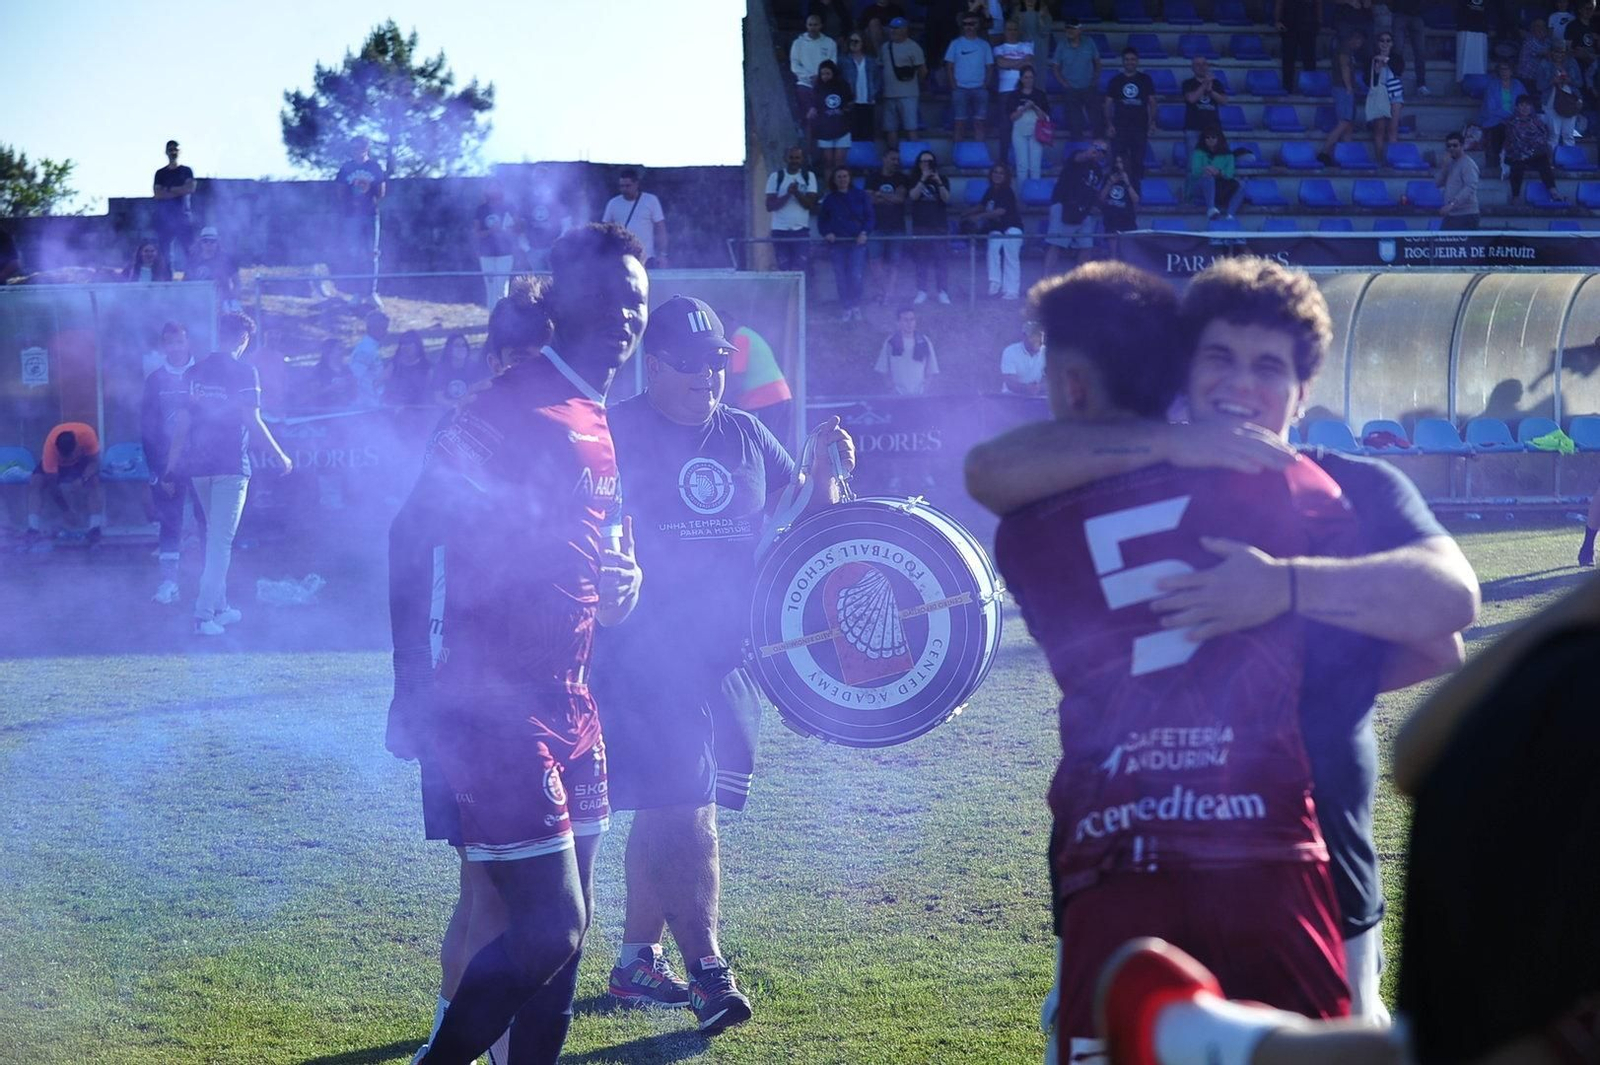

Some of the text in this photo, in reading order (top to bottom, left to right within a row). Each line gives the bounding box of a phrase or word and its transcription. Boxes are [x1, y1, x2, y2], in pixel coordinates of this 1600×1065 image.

[1471, 247, 1486, 258] DE
[689, 519, 734, 528] TEMPADA
[787, 544, 925, 612] FOOTBALL SCHOOL
[808, 639, 943, 704] CENTED ACADEMY
